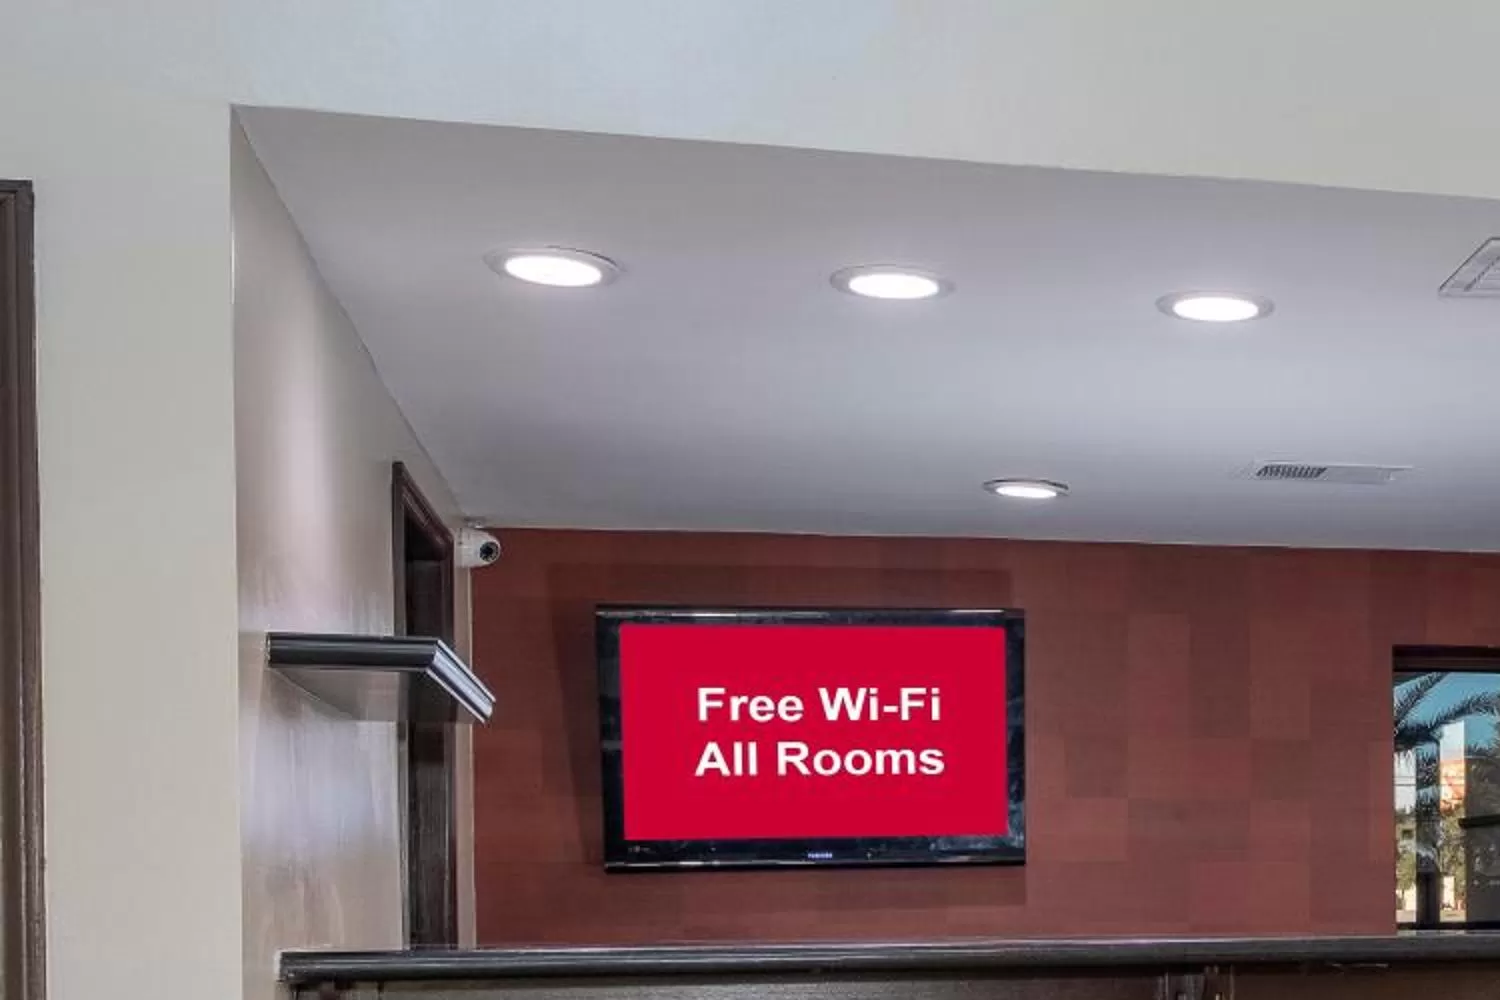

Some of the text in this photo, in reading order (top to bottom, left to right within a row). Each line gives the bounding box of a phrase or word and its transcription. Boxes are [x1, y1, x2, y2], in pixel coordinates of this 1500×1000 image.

[698, 686, 941, 722] Free Wi-Fi
[695, 741, 945, 777] All Rooms
